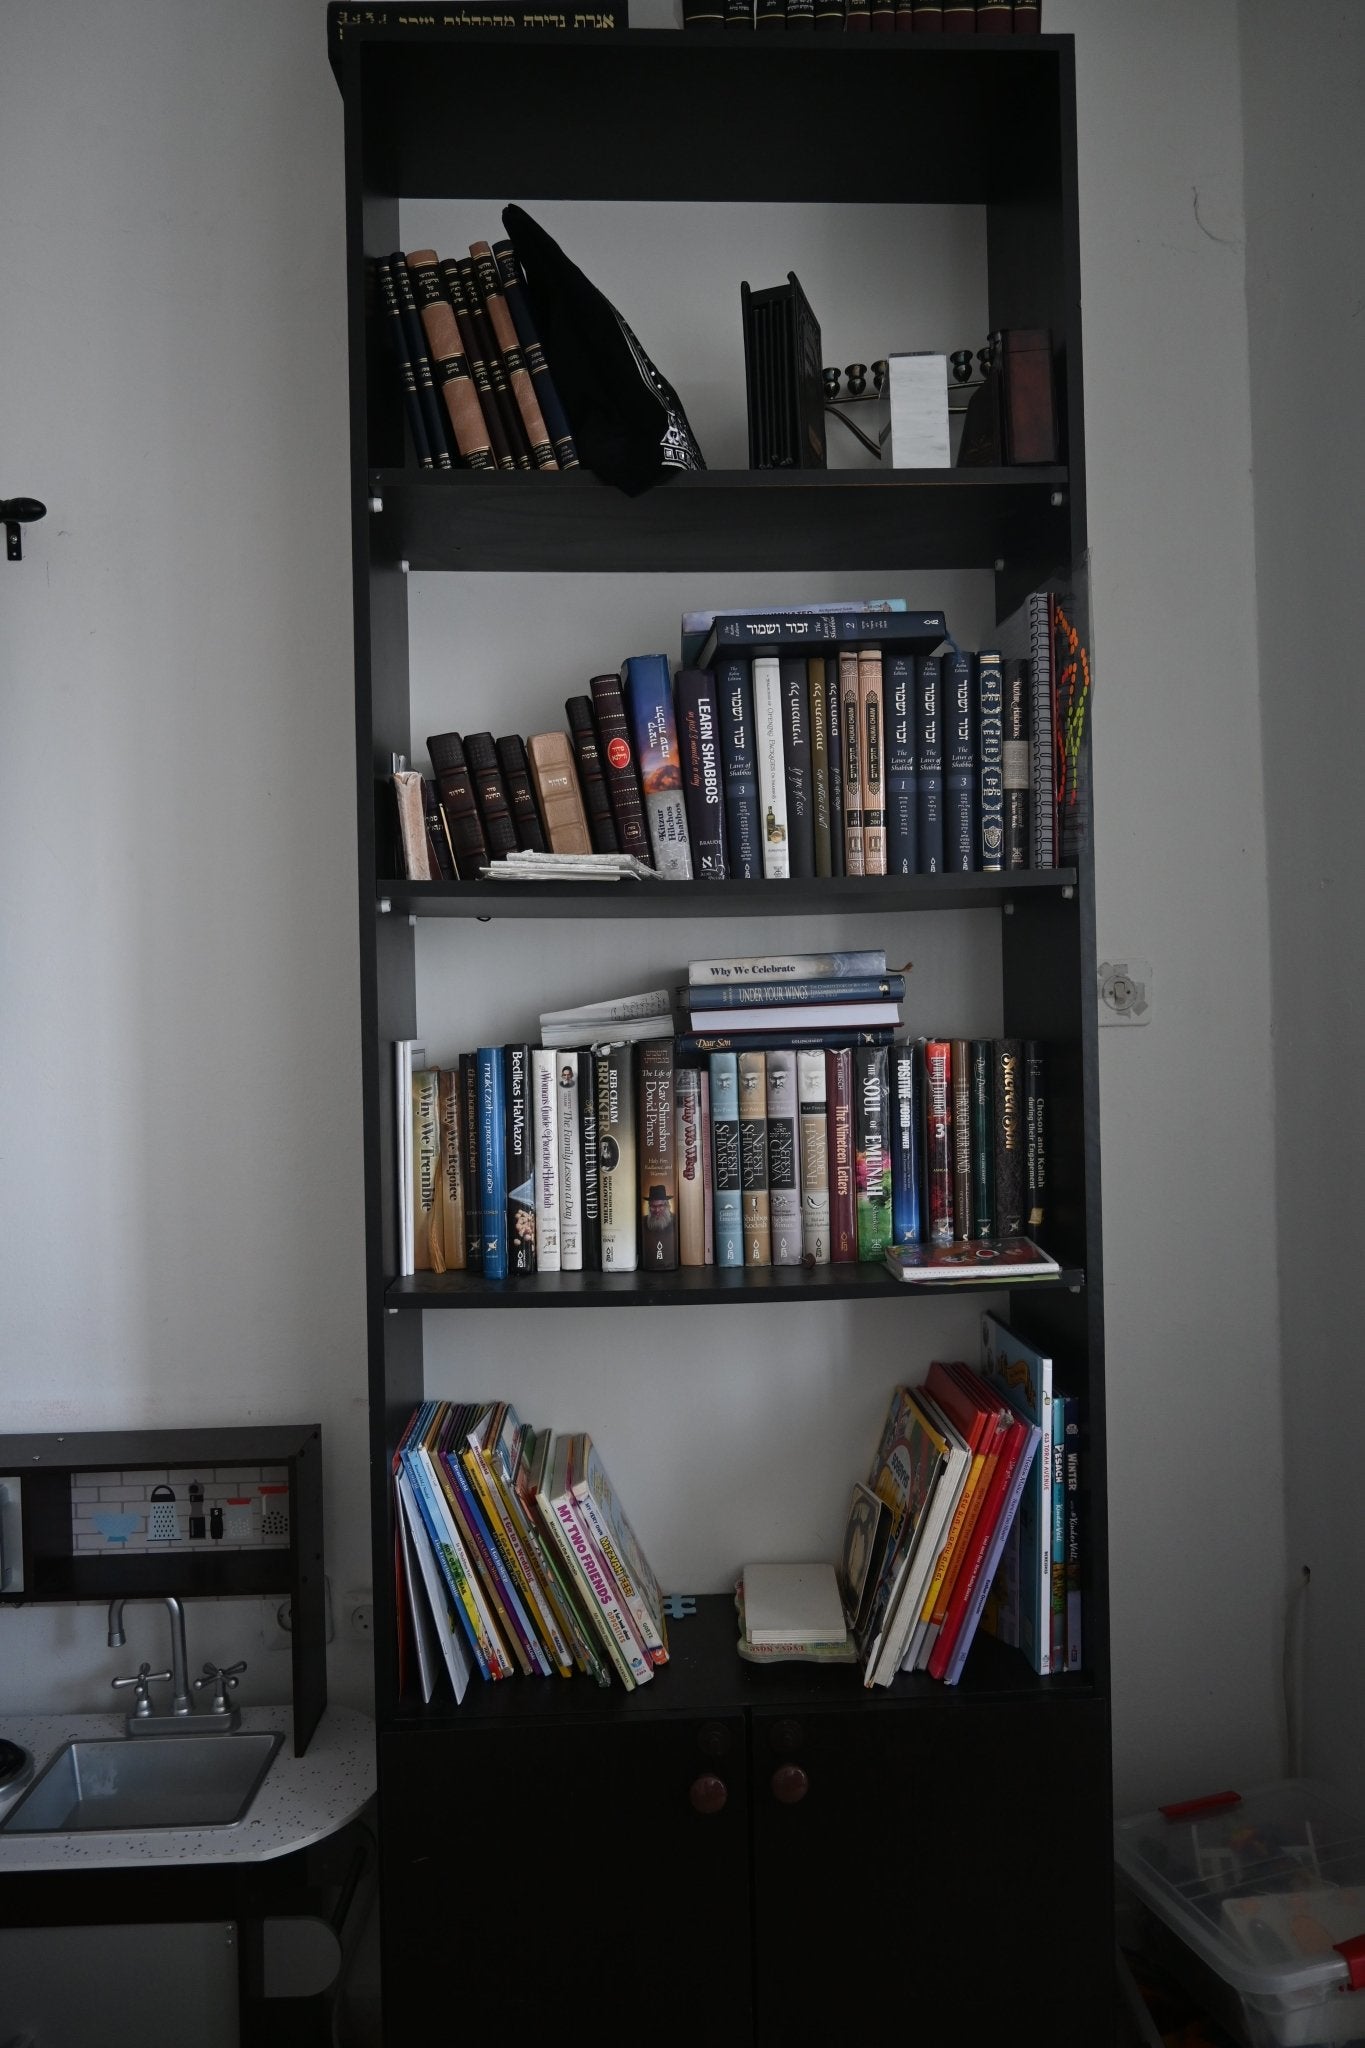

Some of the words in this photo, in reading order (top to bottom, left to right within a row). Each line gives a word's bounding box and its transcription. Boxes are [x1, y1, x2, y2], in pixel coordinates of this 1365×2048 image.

[746, 622, 781, 635] ושמור
[785, 622, 809, 634] זכור
[731, 688, 745, 722] ושמור
[789, 682, 801, 697] על
[812, 682, 822, 697] על
[829, 682, 838, 697] על
[895, 682, 907, 716] ושמור
[924, 682, 936, 716] ושמור
[957, 679, 969, 713] ושמור
[697, 698, 713, 741] LEARN
[814, 699, 824, 751] התשועות
[830, 699, 839, 737] הרחמים
[896, 720, 907, 744] זכור
[925, 720, 936, 744] זכור
[958, 717, 970, 741] זכור
[660, 735, 671, 759] שבת
[733, 726, 746, 750] זכור
[735, 755, 745, 763] The
[767, 739, 777, 774] PACKAGES
[702, 744, 719, 805] SHABBOS
[738, 785, 745, 795] 3
[900, 780, 907, 791] 1
[928, 780, 936, 790] 2
[960, 777, 968, 788] 3
[666, 806, 677, 842] Hilchos
[674, 802, 687, 844] Shabbos
[710, 966, 731, 977] Why
[734, 965, 749, 975] We
[751, 963, 796, 974] Celebrate
[739, 987, 763, 1002] UNDER
[763, 986, 784, 1001] YOUR
[784, 985, 809, 1000] WINGS
[695, 1039, 717, 1048] Dear
[717, 1037, 732, 1047] Son
[511, 1051, 524, 1097] Bedikas
[608, 1069, 618, 1087] REB
[642, 1069, 653, 1078] The
[654, 1069, 665, 1079] Life
[665, 1069, 673, 1080] of
[867, 1064, 876, 1077] THE
[897, 1059, 912, 1099] POSITIVE
[930, 1055, 947, 1081] Living
[1000, 1053, 1017, 1113] Sacred
[416, 1085, 433, 1118] Why
[598, 1060, 611, 1133] BRISKER
[609, 1088, 619, 1124] CHAIM
[646, 1081, 658, 1112] Dovid
[658, 1081, 670, 1100] Rav
[863, 1077, 881, 1118] SOUL
[931, 1082, 948, 1118] Emunah
[443, 1094, 458, 1126] Why
[563, 1110, 573, 1127] The
[682, 1094, 697, 1122] Why
[835, 1104, 848, 1122] The
[956, 1090, 971, 1125] THROUGH
[1026, 1096, 1035, 1121] during
[1036, 1097, 1046, 1134] Choson
[420, 1120, 434, 1145] We
[446, 1129, 458, 1149] We
[512, 1099, 525, 1156] HaMazon
[646, 1114, 658, 1147] Pincus
[658, 1102, 671, 1153] Shimshon
[684, 1124, 697, 1145] We
[869, 1120, 876, 1129] OF
[935, 1123, 946, 1139] 3
[956, 1128, 971, 1147] YOUR
[1027, 1123, 1036, 1141] their
[563, 1129, 574, 1161] Family
[715, 1123, 729, 1189] SHIMSHON
[726, 1132, 738, 1177] NEFESH
[740, 1123, 754, 1189] SHIMSHON
[752, 1132, 765, 1178] NEFESH
[780, 1136, 792, 1182] NEFESH
[836, 1123, 849, 1164] Nineteen
[1037, 1136, 1046, 1155] and
[564, 1162, 573, 1191] Lesson
[683, 1146, 697, 1181] Weep
[770, 1139, 782, 1184] CHAYA
[865, 1133, 884, 1197] EMUNAH
[957, 1148, 972, 1174] HANDS
[1027, 1142, 1037, 1189] Engagement
[1037, 1157, 1047, 1188] Kallah
[420, 1149, 435, 1213] Tremble
[445, 1153, 458, 1202] Rejoice
[585, 1142, 599, 1219] ILLUMINATED
[837, 1165, 849, 1196] Letters
[564, 1199, 574, 1221] Day
[1054, 1443, 1065, 1484] PESACH
[1066, 1452, 1078, 1492] WINTER
[589, 1511, 598, 1525] VERY
[595, 1524, 603, 1536] OWN
[516, 1548, 535, 1583] Wedding
[557, 1503, 574, 1523] MY
[567, 1520, 587, 1554] TWO
[580, 1552, 613, 1605] FRIENDS
[600, 1536, 625, 1576] MITZVAH
[619, 1571, 635, 1598] FEET
[606, 1611, 627, 1645] OPPOSITES
